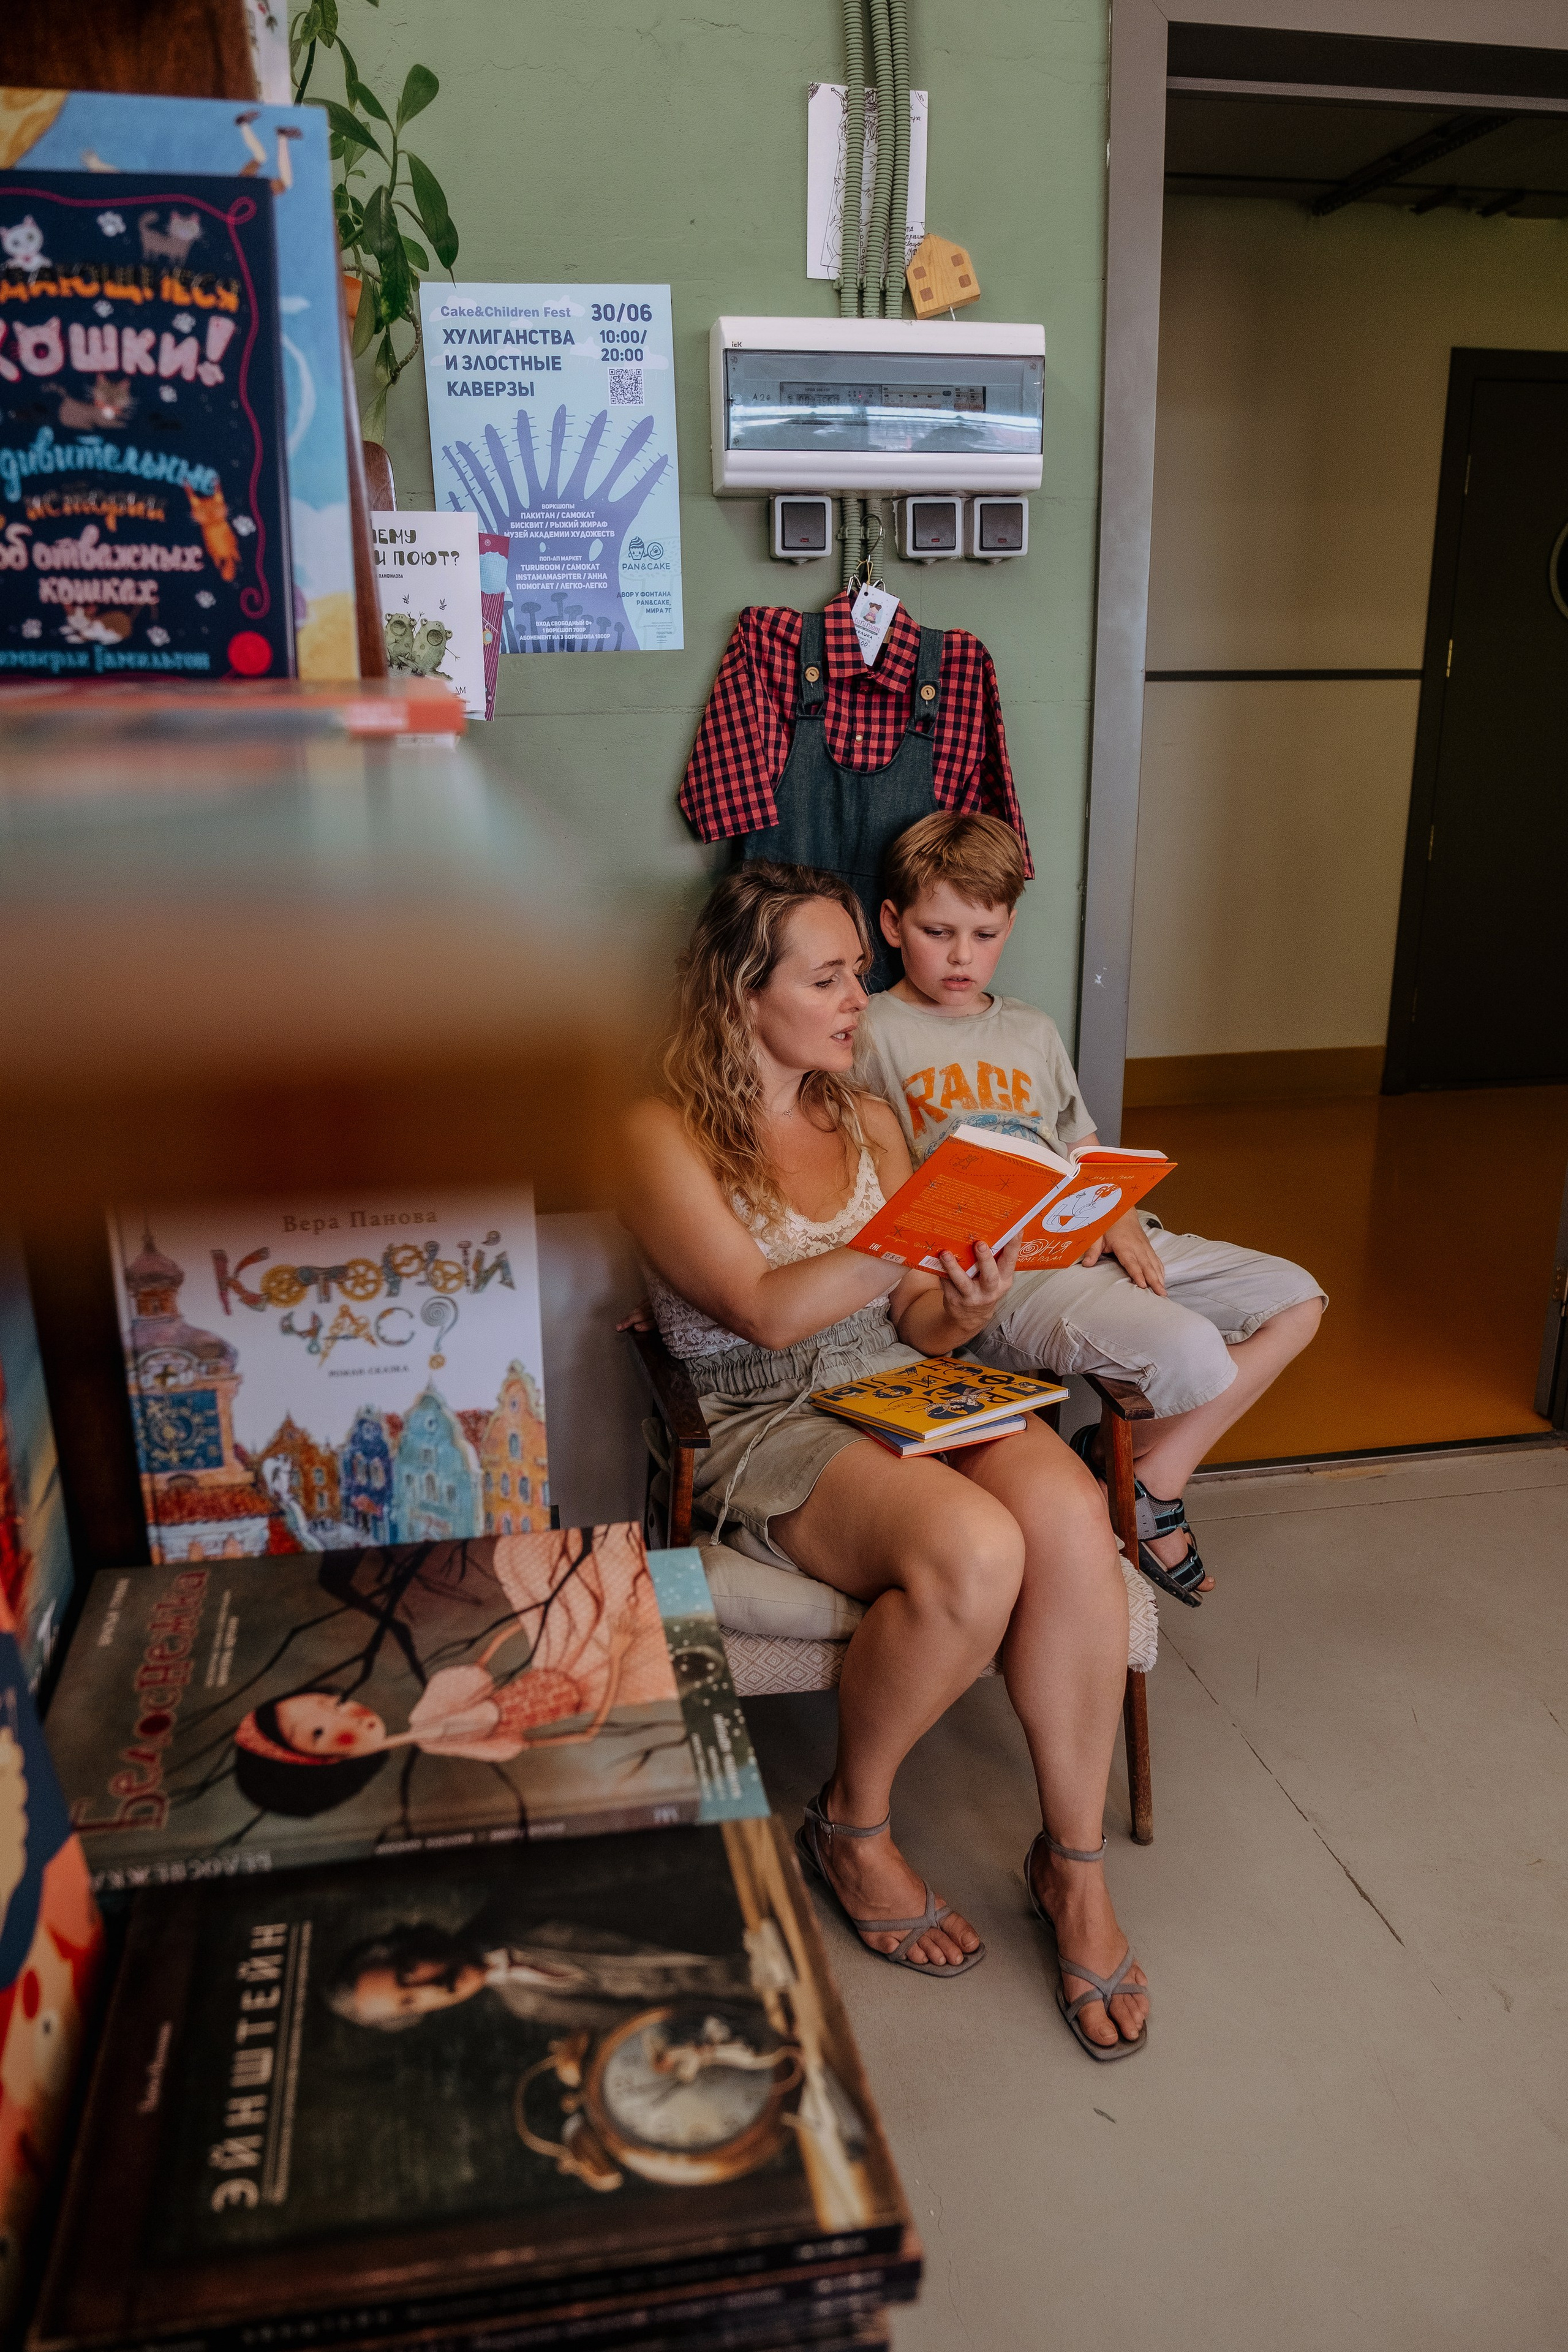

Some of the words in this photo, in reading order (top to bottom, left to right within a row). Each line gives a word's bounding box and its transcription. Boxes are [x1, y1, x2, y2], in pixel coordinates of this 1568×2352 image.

[440, 306, 540, 317] Cake&Children
[544, 307, 571, 318] Fest
[591, 303, 652, 323] 30/06
[442, 328, 575, 345] ХУЛИГАНСТВА
[600, 330, 647, 344] 10:00/
[445, 355, 458, 371] И
[462, 355, 562, 371] ЗЛОСТНЫЕ
[601, 348, 644, 362] 20:00
[447, 381, 535, 397] КАВЕРЗЫ
[549, 519, 580, 529] РЫЖИЙ
[503, 530, 529, 538] МУЗЕЙ
[32, 524, 205, 571] отважных
[393, 550, 460, 566] ПОЮТ?
[39, 577, 160, 605] кошках
[902, 1060, 1041, 1140] RACE
[283, 1215, 340, 1235] Вера
[349, 1209, 438, 1228] Панова
[884, 1253, 901, 1261] 980
[280, 1295, 458, 1371] ЧАС?
[207, 1922, 288, 2212] ЭЙНШТЕЙН
